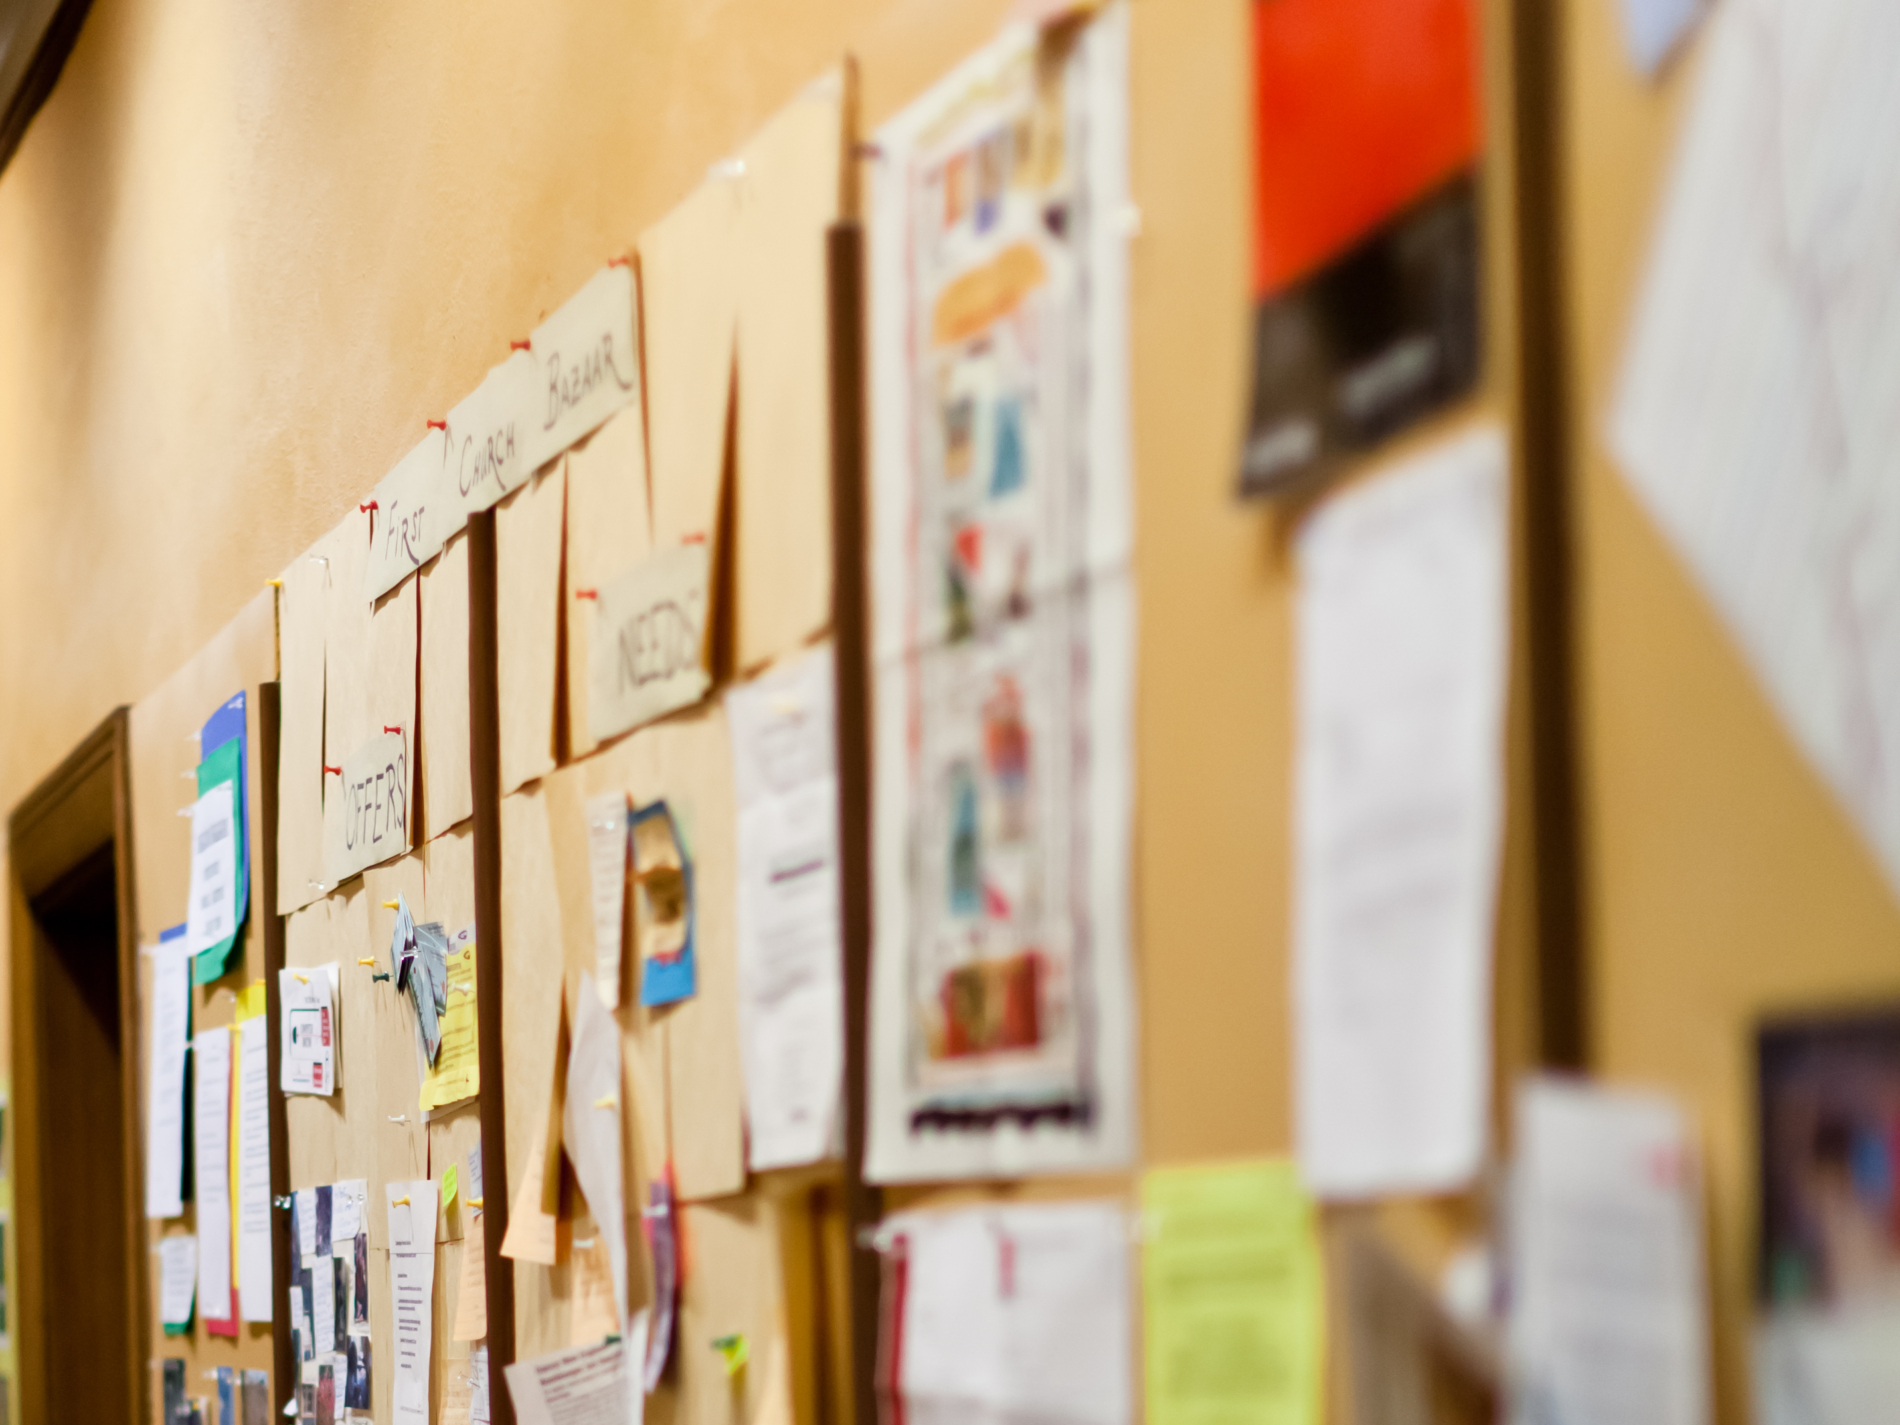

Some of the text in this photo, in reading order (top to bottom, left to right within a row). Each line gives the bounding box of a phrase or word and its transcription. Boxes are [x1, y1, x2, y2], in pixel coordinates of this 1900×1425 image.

[459, 421, 516, 498] CHURCH
[543, 331, 634, 431] BAZAAR
[345, 753, 404, 851] OFFERS
